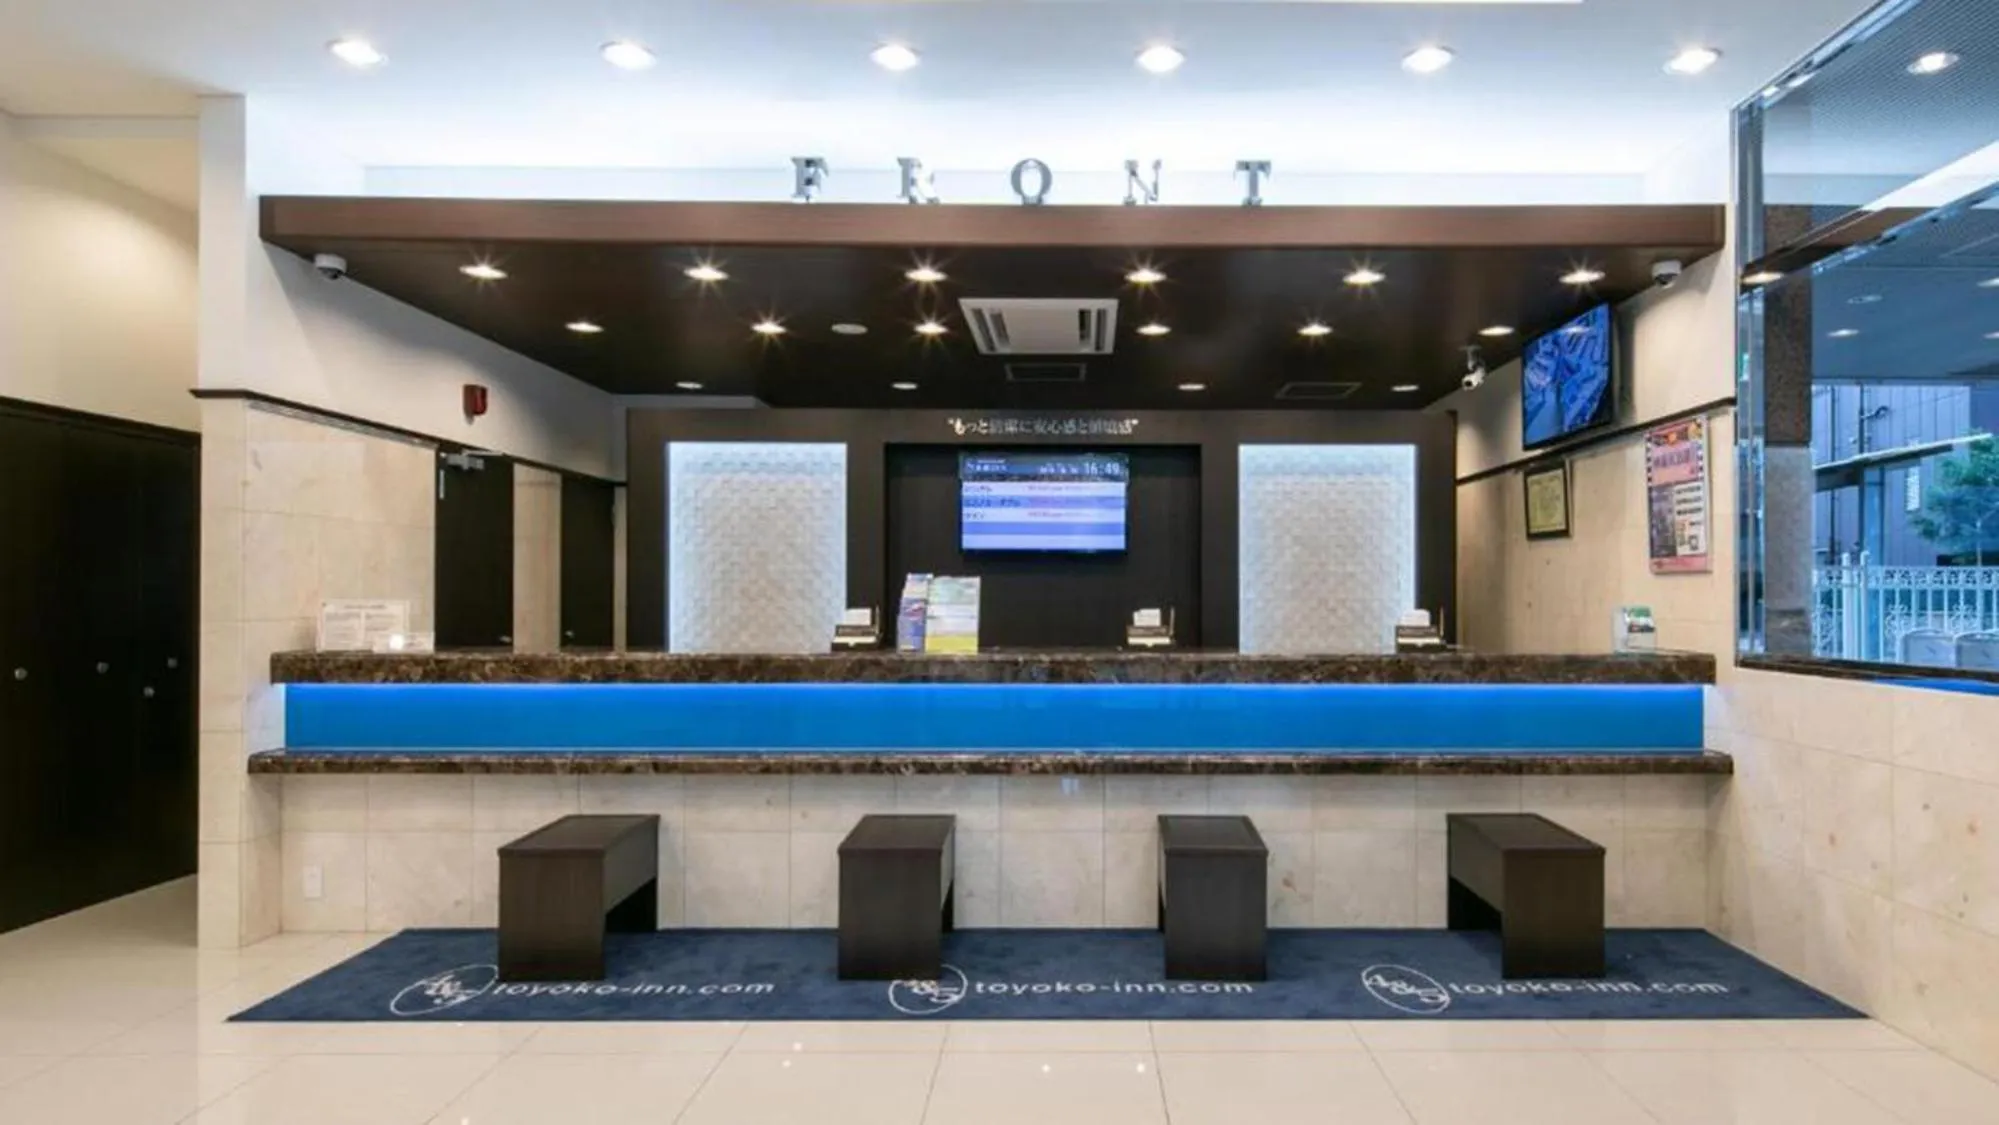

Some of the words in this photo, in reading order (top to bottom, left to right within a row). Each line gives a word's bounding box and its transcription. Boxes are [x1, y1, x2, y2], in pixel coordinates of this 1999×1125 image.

[791, 156, 1272, 206] FRONT
[1083, 462, 1121, 475] 16:49
[493, 980, 775, 997] toyoko-inn.com
[975, 980, 1253, 996] toyoko-inn.com
[1448, 979, 1729, 996] toyoko-inn.com
